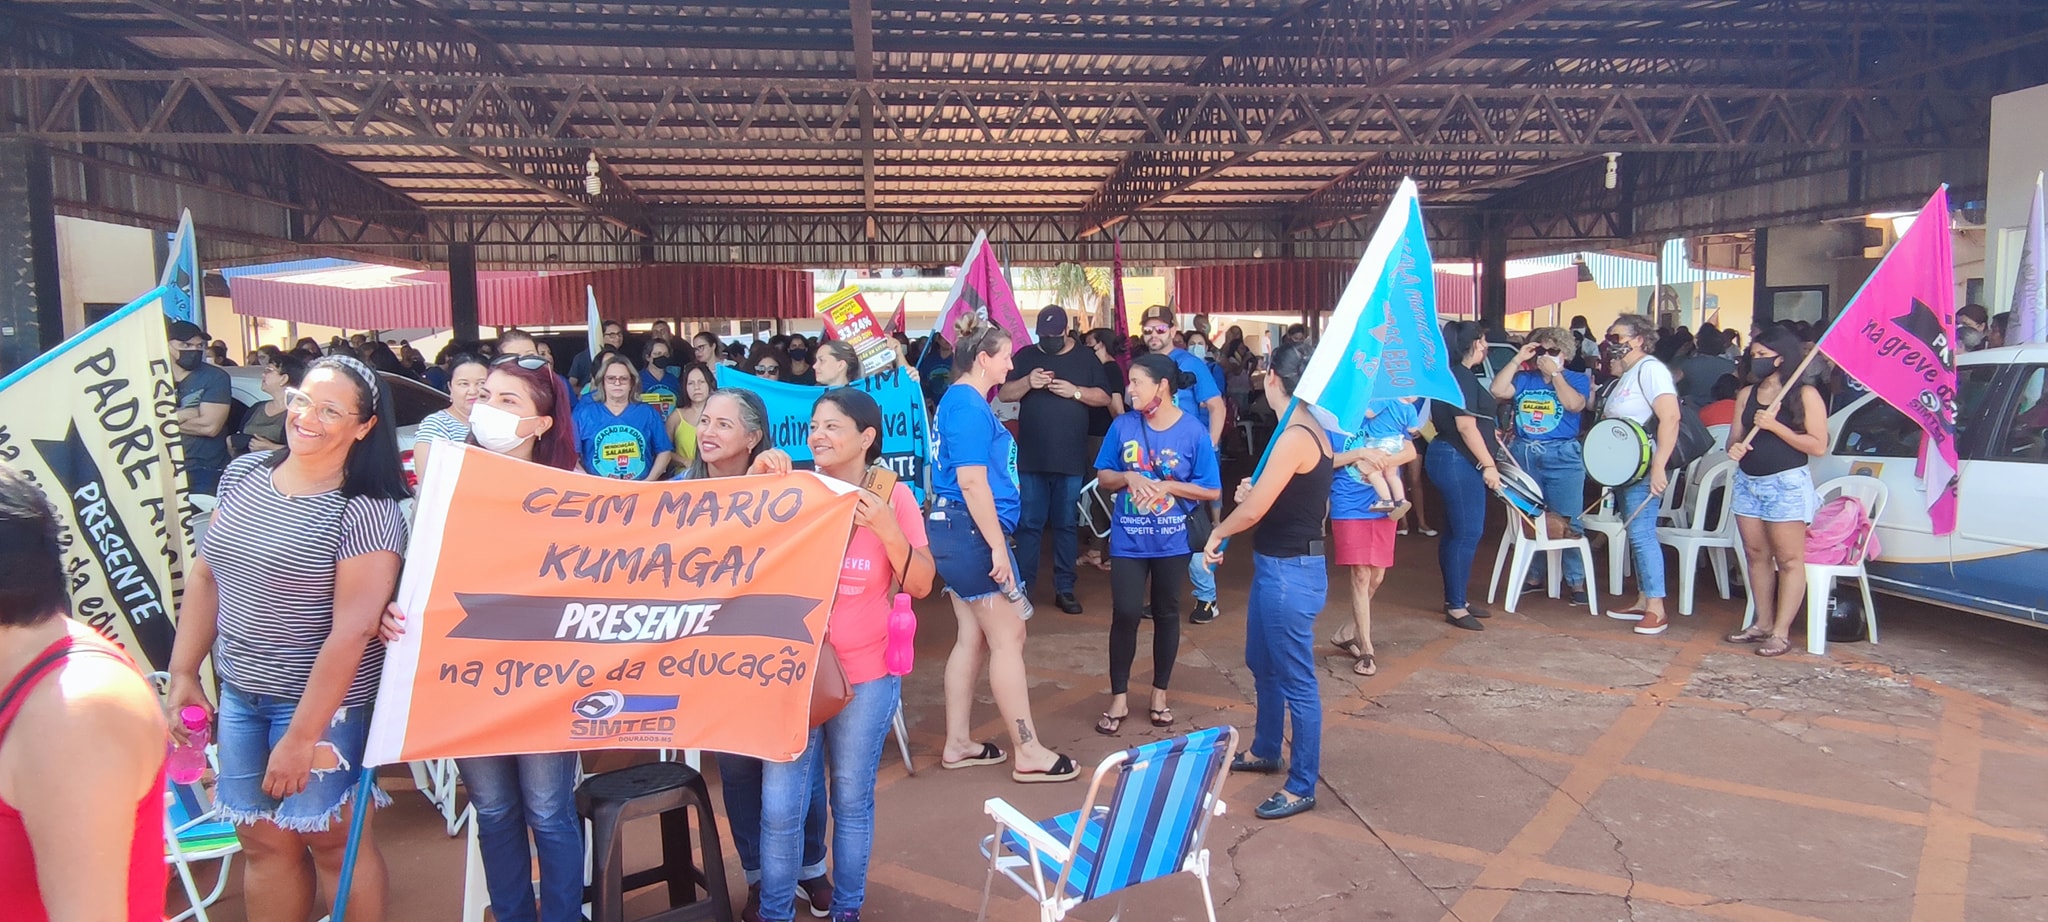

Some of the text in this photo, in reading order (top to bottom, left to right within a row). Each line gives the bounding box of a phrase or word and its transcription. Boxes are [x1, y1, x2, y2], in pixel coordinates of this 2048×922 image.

[838, 316, 873, 341] 33,24%
[1382, 350, 1416, 387] BELO
[1861, 319, 1885, 343] na
[1878, 336, 1938, 382] greve
[74, 347, 160, 490] PADRE
[521, 486, 804, 529] CEIM MARIO
[1120, 516, 1151, 526] CONHEÇA
[74, 481, 163, 625] PRESENTE
[538, 542, 766, 588] KUMAGAI
[554, 601, 723, 642] PRESENTE
[438, 646, 807, 696] na greve da educação
[570, 715, 677, 737] SIMTED
